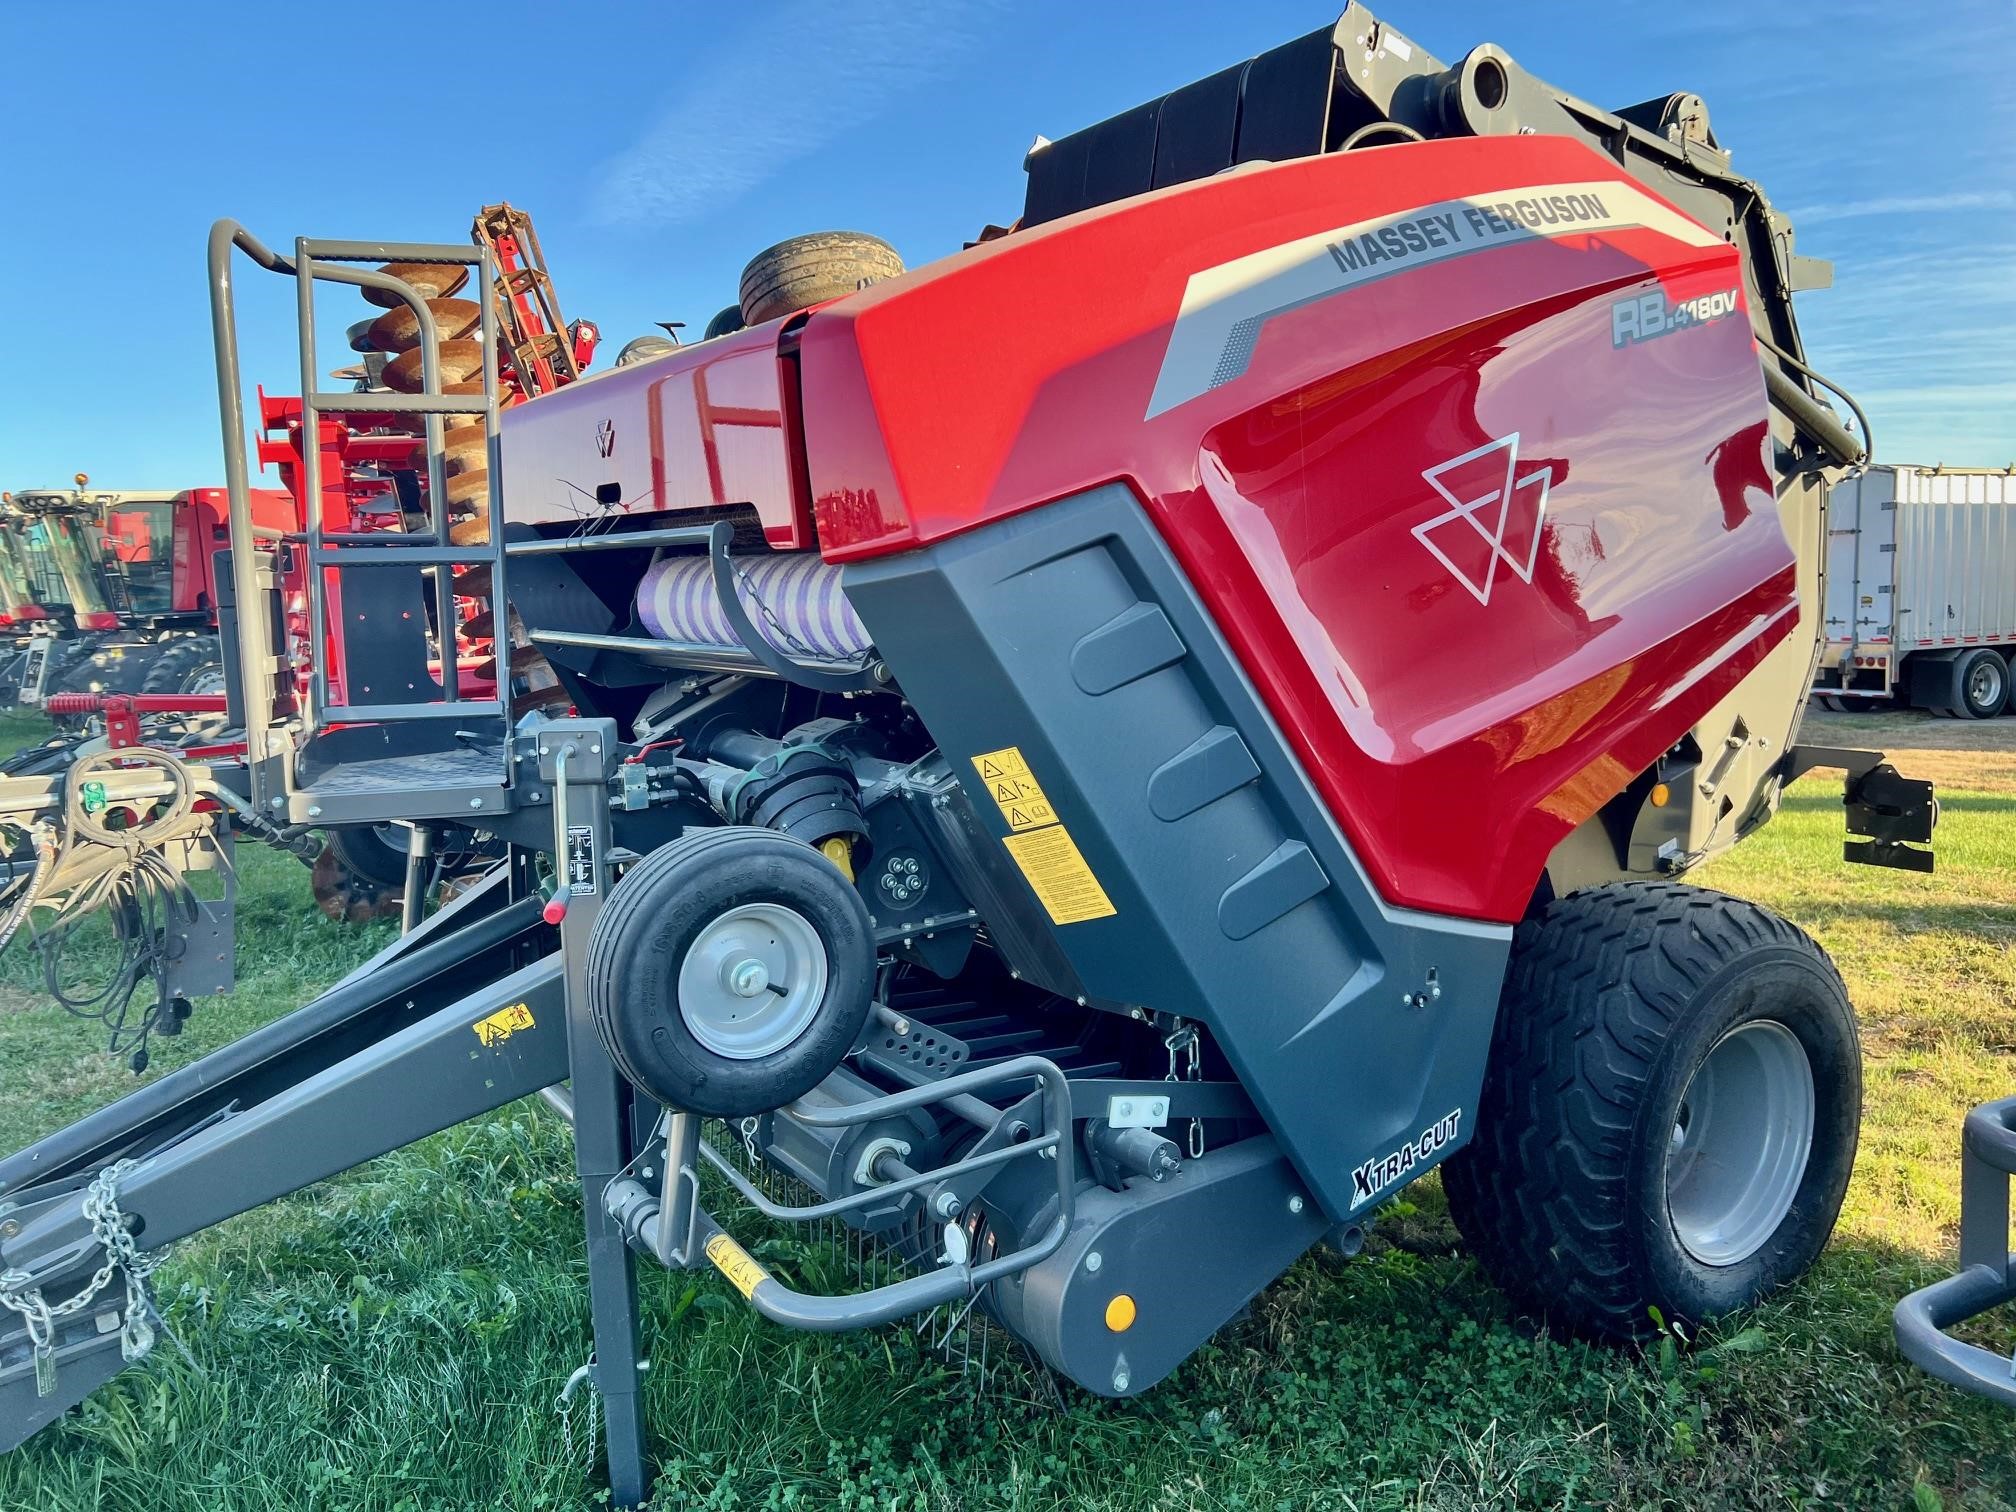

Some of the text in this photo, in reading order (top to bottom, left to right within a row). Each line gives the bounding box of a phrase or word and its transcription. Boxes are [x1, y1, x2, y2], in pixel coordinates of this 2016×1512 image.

[1326, 193, 1610, 273] MASSEY FERGUSON
[1350, 1107, 1462, 1211] XTRA-CUT
